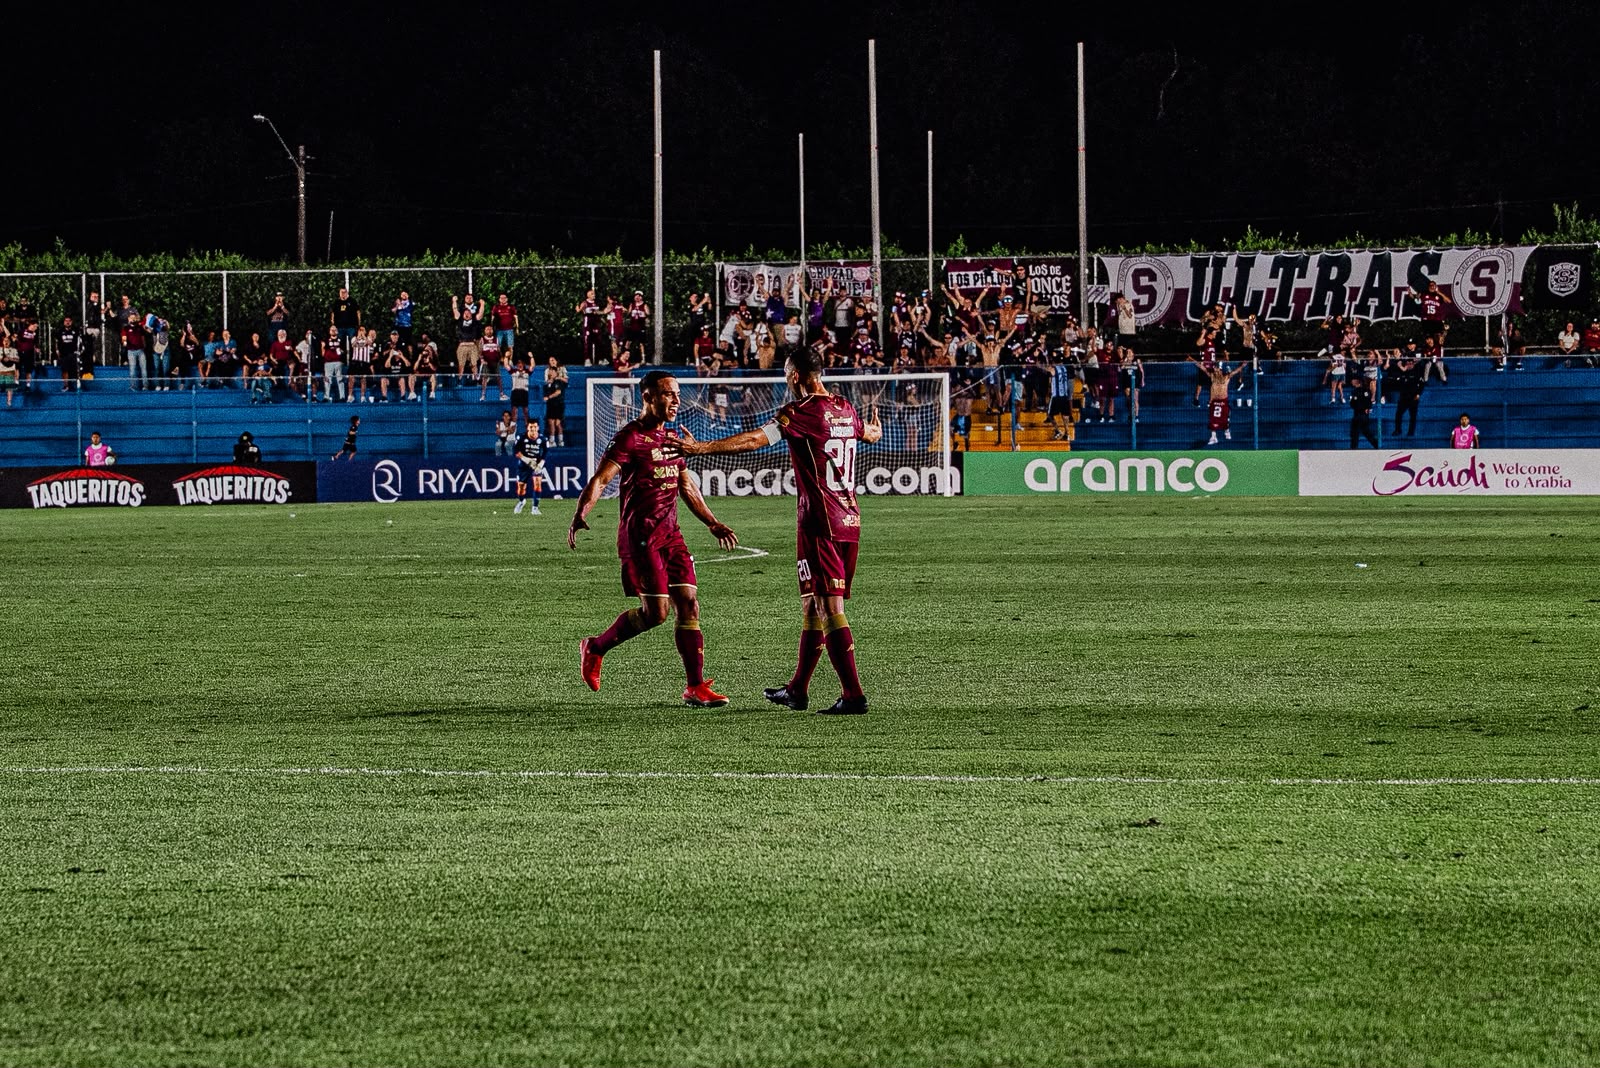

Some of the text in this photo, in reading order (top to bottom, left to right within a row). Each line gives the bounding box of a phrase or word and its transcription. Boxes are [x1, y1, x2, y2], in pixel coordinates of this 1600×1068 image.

[949, 273, 970, 288] LOS
[1029, 264, 1061, 276] LOS DE
[1468, 260, 1500, 305] S
[1032, 275, 1072, 294] ONCE
[1131, 267, 1157, 314] S
[1187, 252, 1442, 322] ULTRAS
[1427, 305, 1436, 315] 15
[1460, 301, 1485, 316] COSTA
[825, 439, 857, 492] 20
[1024, 458, 1229, 492] aramco
[1373, 452, 1490, 495] Saudi
[1492, 463, 1561, 475] Welcome
[27, 479, 145, 508] TAQUERITOS
[173, 476, 290, 505] TAQUERITOS
[418, 466, 583, 494] RIYADH AIR
[1505, 476, 1572, 488] to Arabia
[797, 559, 811, 582] 20
